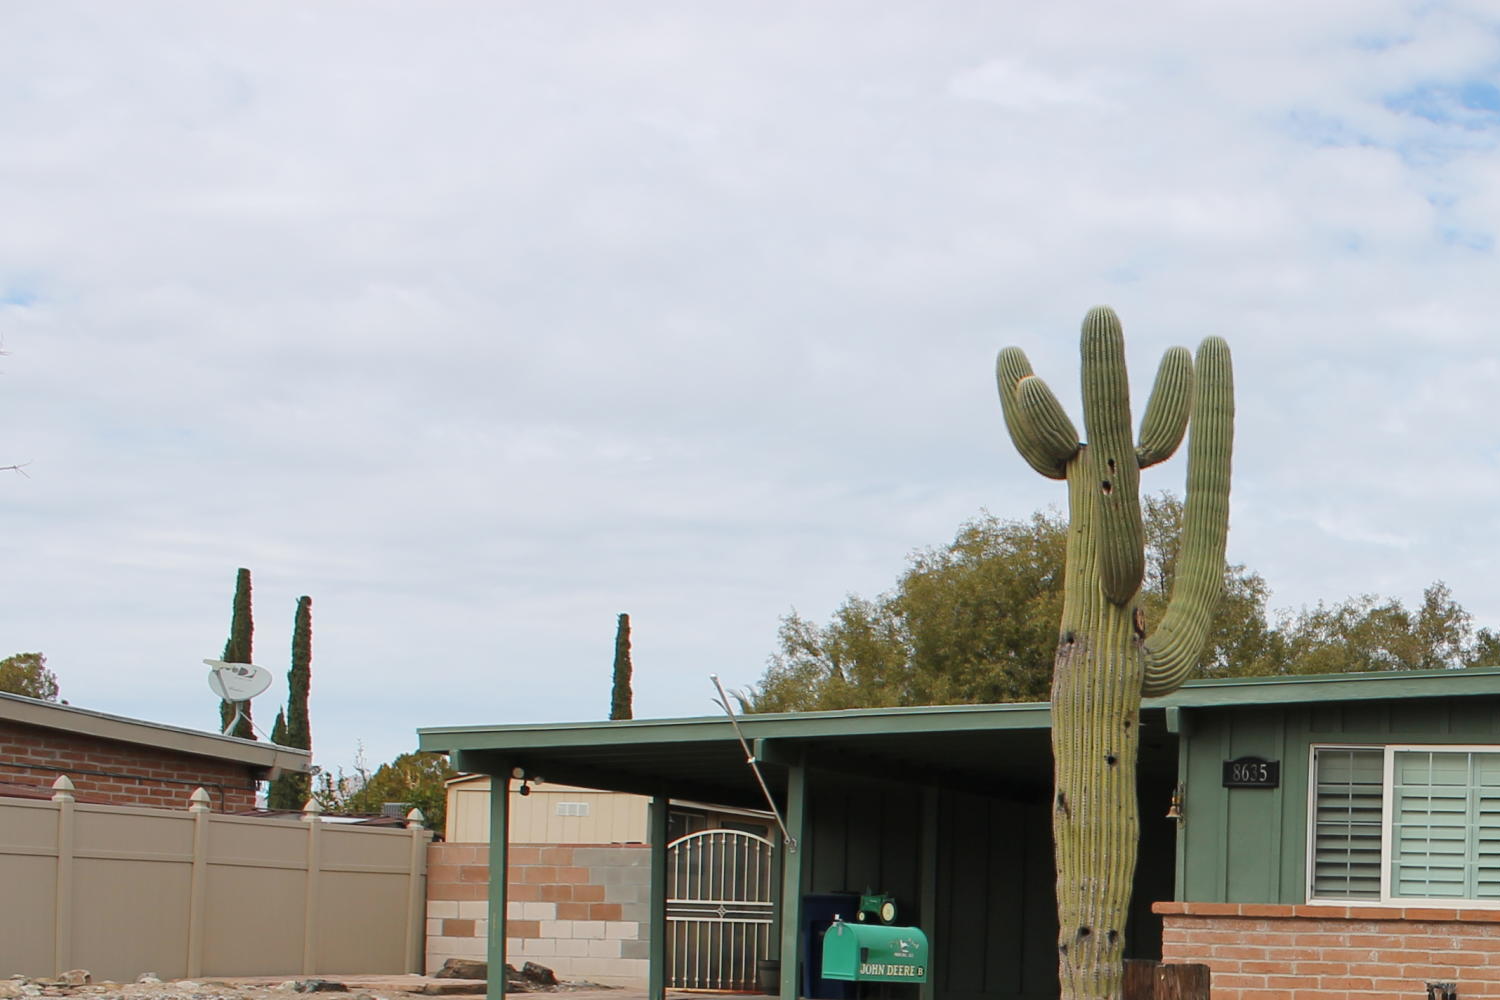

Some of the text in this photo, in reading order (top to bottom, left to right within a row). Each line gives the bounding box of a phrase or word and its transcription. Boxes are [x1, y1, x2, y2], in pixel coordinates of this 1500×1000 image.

[1232, 763, 1268, 782] 8635
[860, 963, 885, 975] JOHN
[886, 964, 915, 977] DEERE
